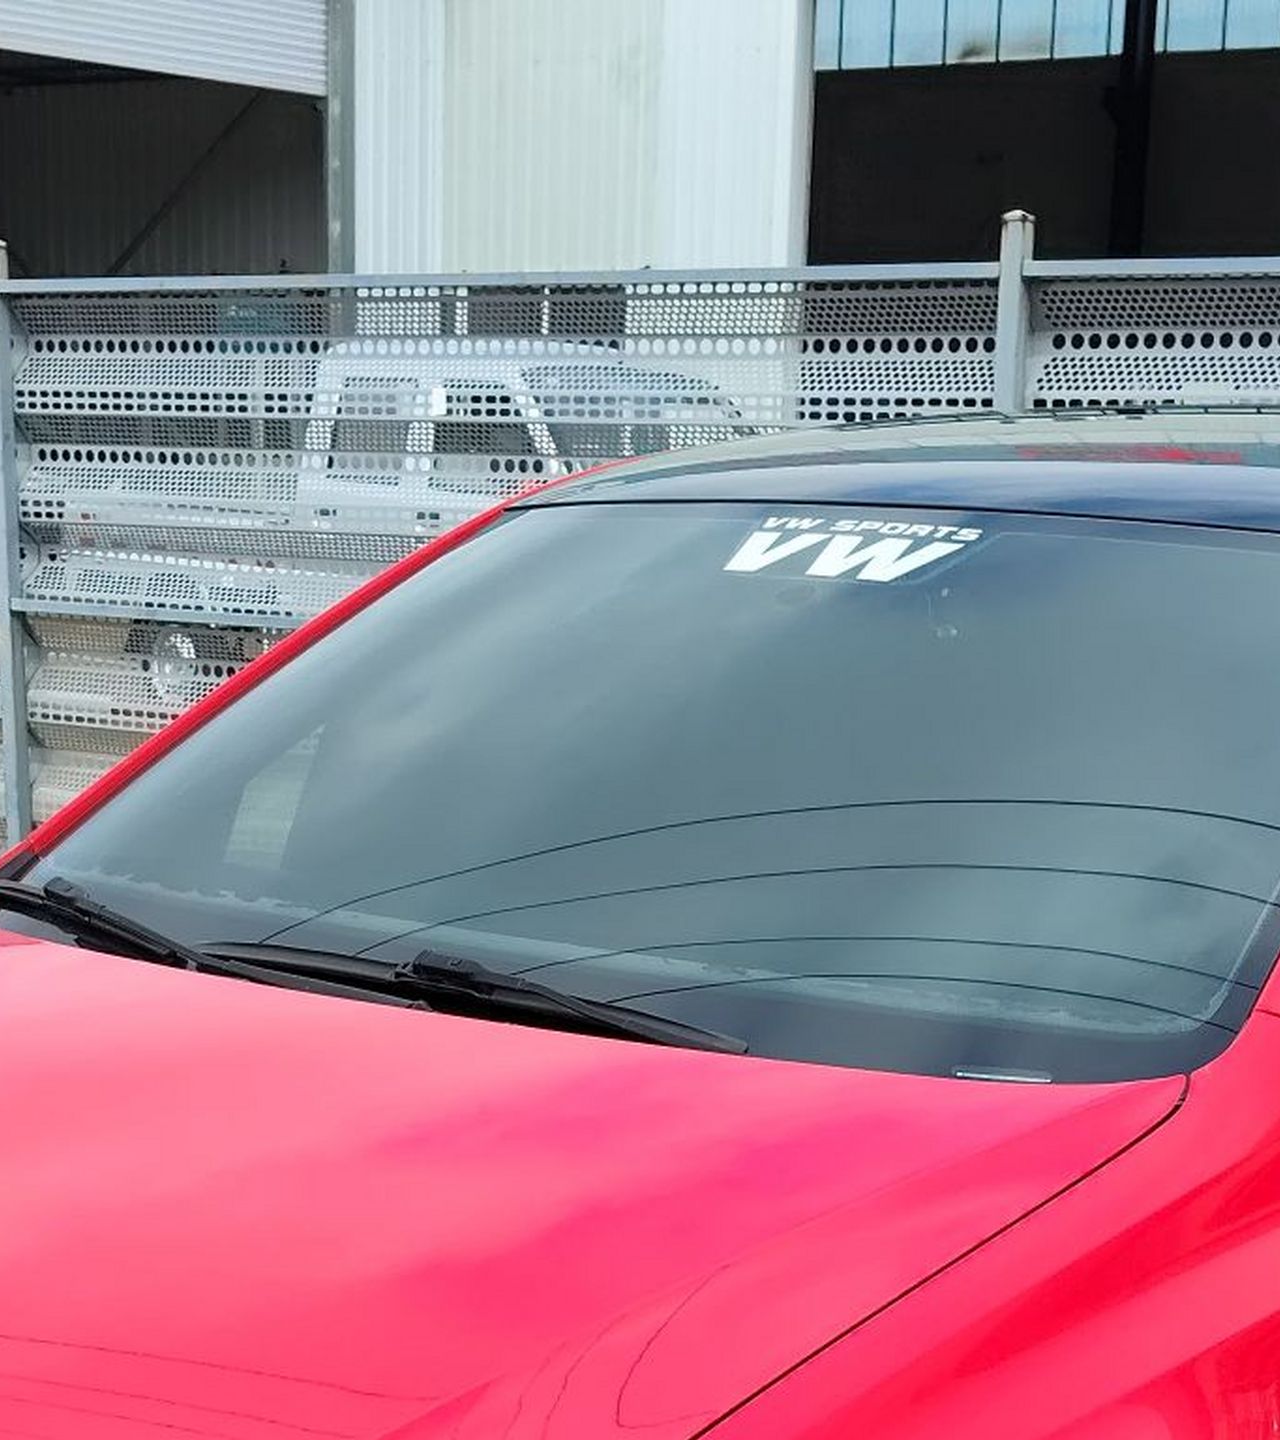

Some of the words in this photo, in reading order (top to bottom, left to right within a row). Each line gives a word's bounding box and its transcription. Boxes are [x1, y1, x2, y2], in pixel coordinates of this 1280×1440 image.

[762, 517, 825, 530] VW
[829, 519, 983, 541] SPORTS
[723, 531, 966, 582] VW
